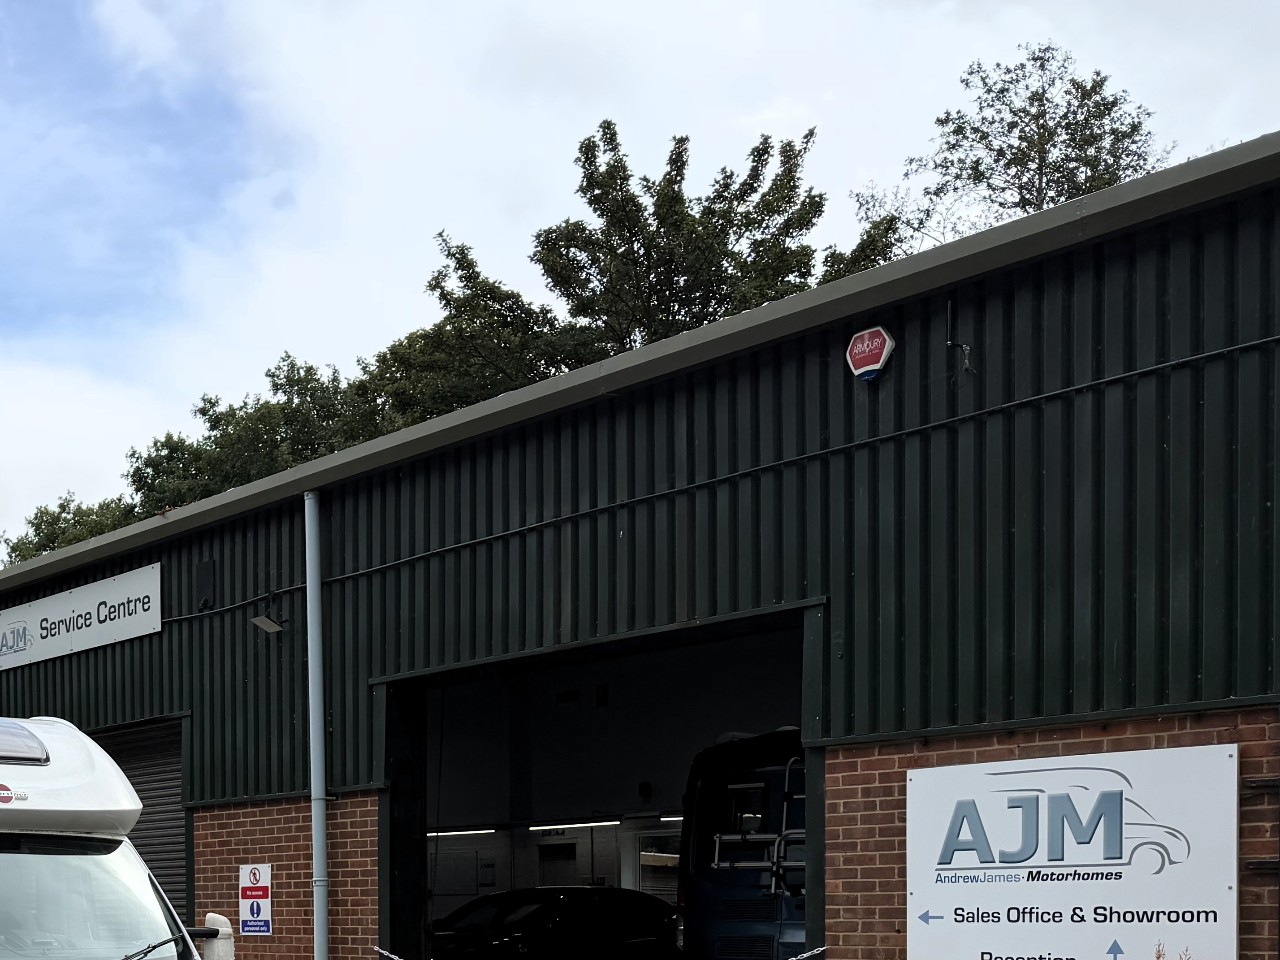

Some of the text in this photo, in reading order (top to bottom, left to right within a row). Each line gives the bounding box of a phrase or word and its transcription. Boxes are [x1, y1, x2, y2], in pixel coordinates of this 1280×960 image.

[39, 594, 151, 640] Service Centre
[0, 626, 27, 652] AJM
[937, 789, 1124, 866] AJM
[1026, 869, 1123, 883] Motorhomes
[953, 905, 1218, 924] Sales Office & Showroom
